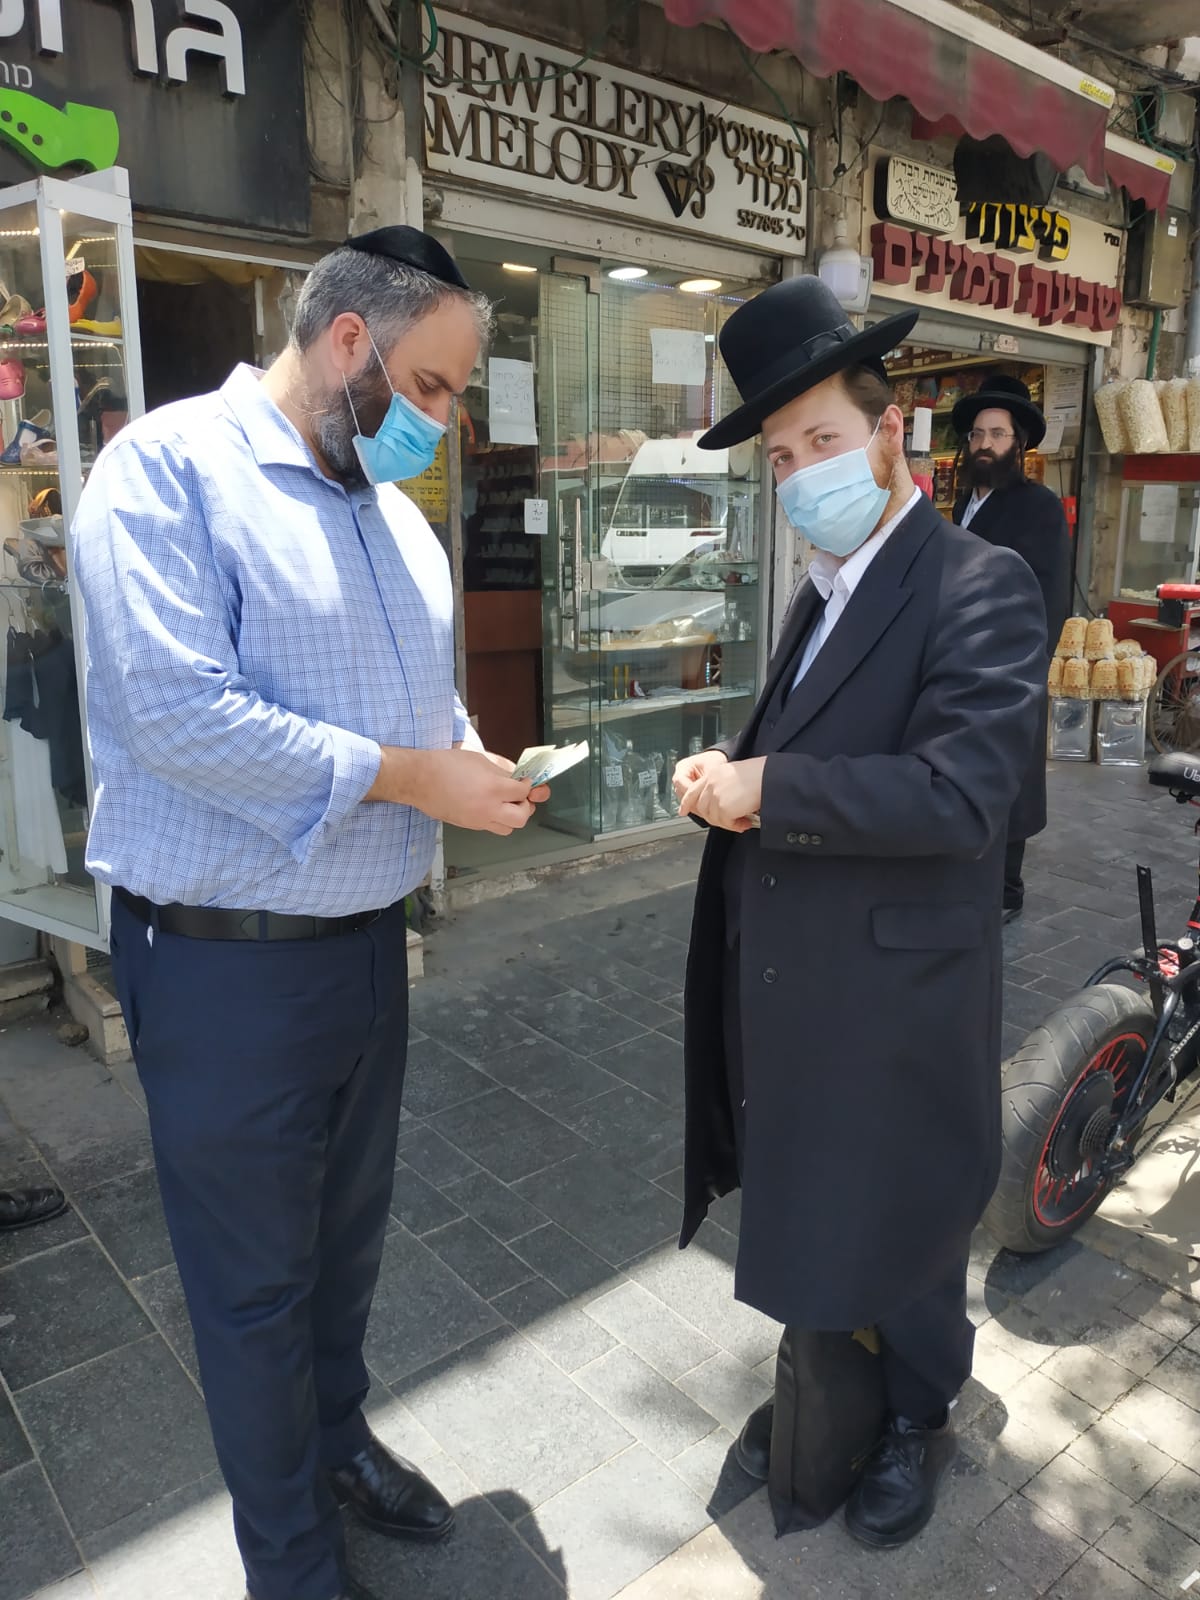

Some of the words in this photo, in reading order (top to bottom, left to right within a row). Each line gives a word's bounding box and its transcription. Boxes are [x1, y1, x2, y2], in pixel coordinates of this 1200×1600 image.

[427, 26, 700, 157] JEWELERY
[427, 91, 645, 200] MELODY
[735, 157, 802, 214] מלודי
[872, 223, 1016, 309] המינים
[1018, 264, 1122, 332] שבעת
